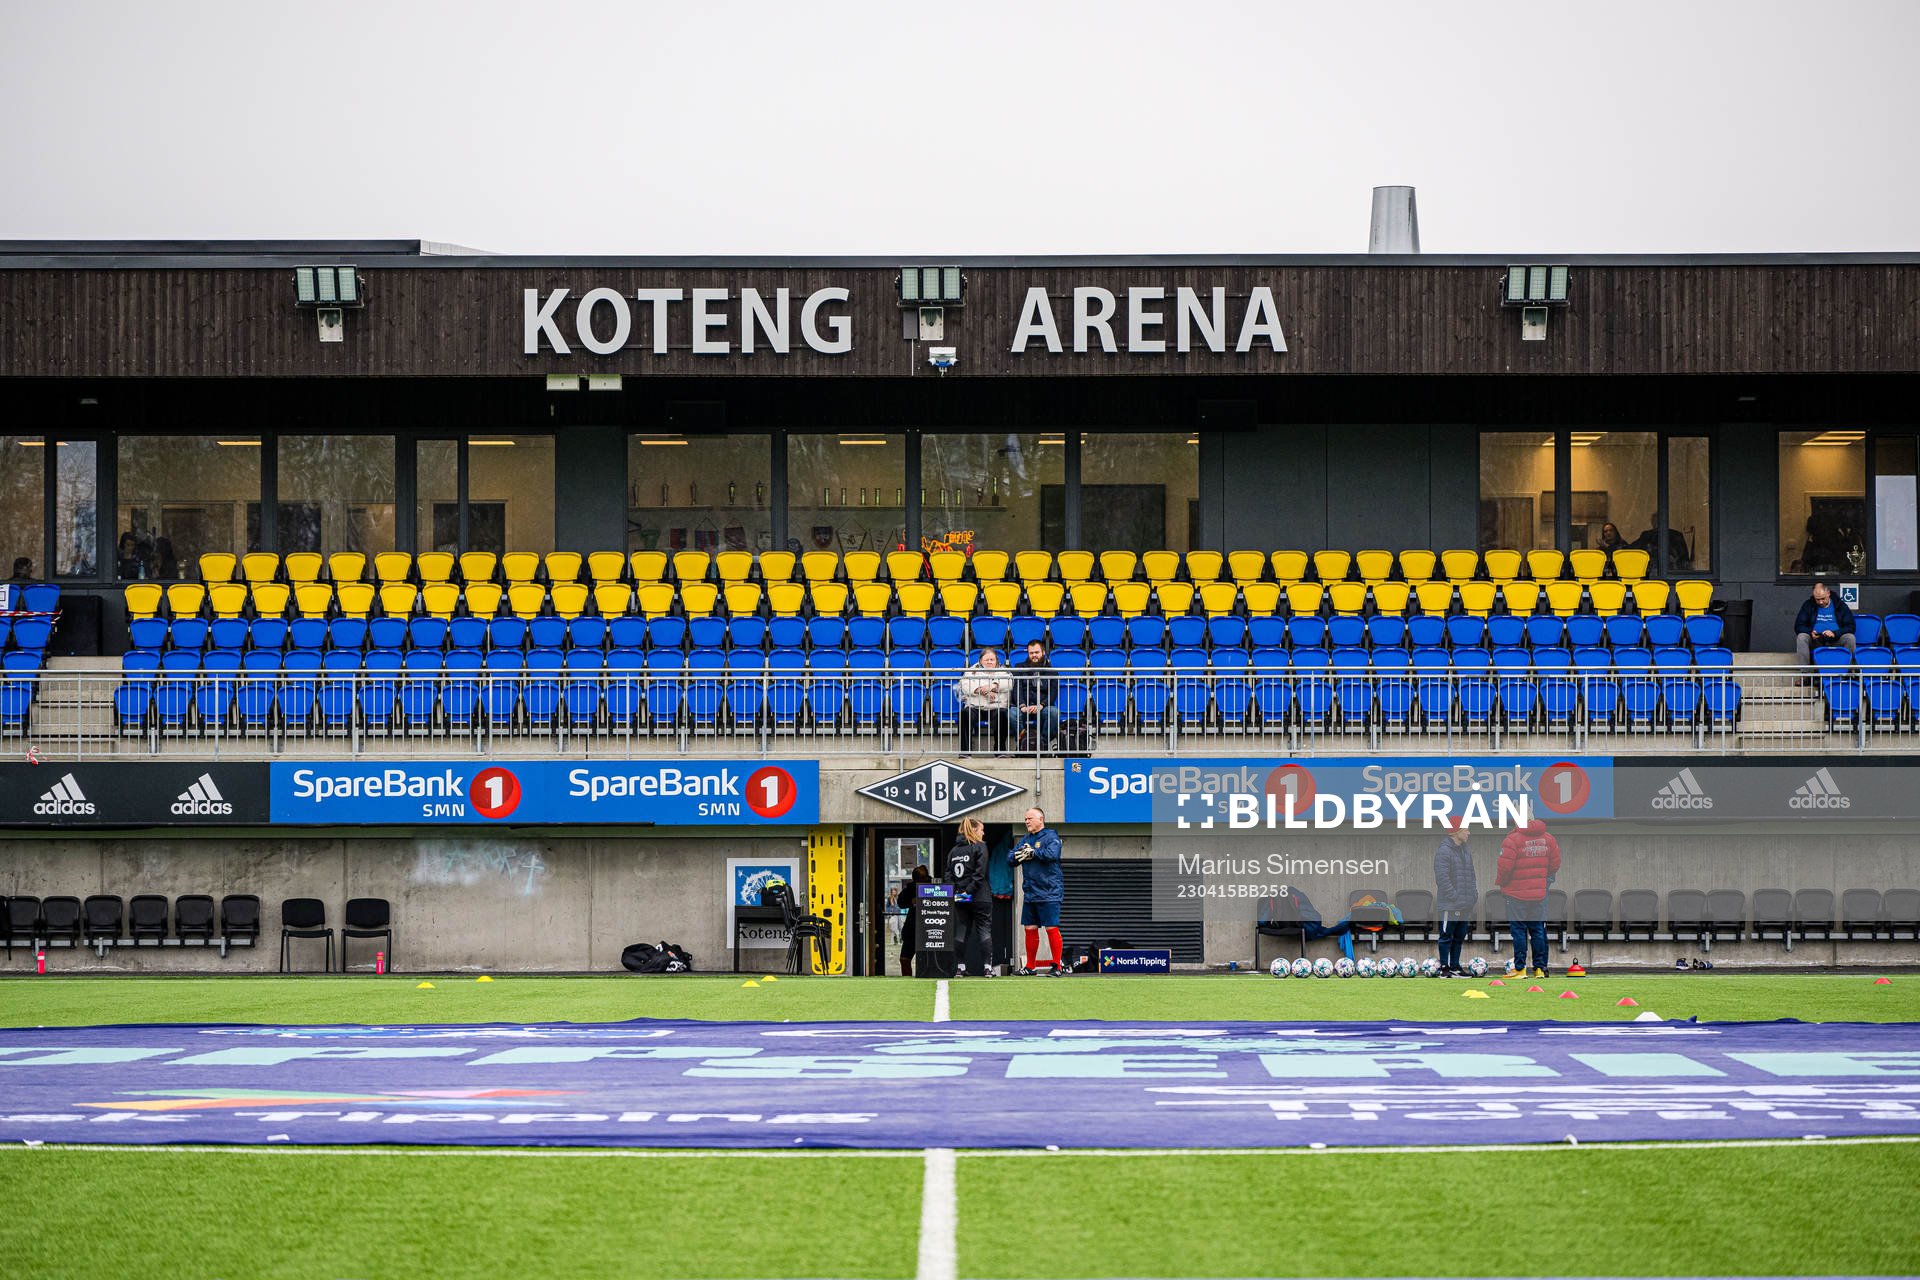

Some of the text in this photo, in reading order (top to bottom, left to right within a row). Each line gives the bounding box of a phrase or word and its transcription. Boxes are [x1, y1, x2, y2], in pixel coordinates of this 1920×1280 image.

[523, 285, 1288, 355] KOTENG ARENA
[293, 768, 504, 809] SpareBank 1
[568, 767, 779, 809] SpareBank 1
[884, 781, 997, 802] 19 RBK 17
[1088, 765, 1298, 804] SpareBank 1
[1362, 764, 1572, 804] SpareBank 1
[33, 799, 96, 815] adidas
[171, 799, 233, 815] adidas
[698, 802, 741, 816] SMN
[1651, 793, 1713, 809] adidas
[1789, 793, 1851, 809] adidas
[422, 803, 465, 817] SMN
[1116, 957, 1167, 967] Norsk Tipping
